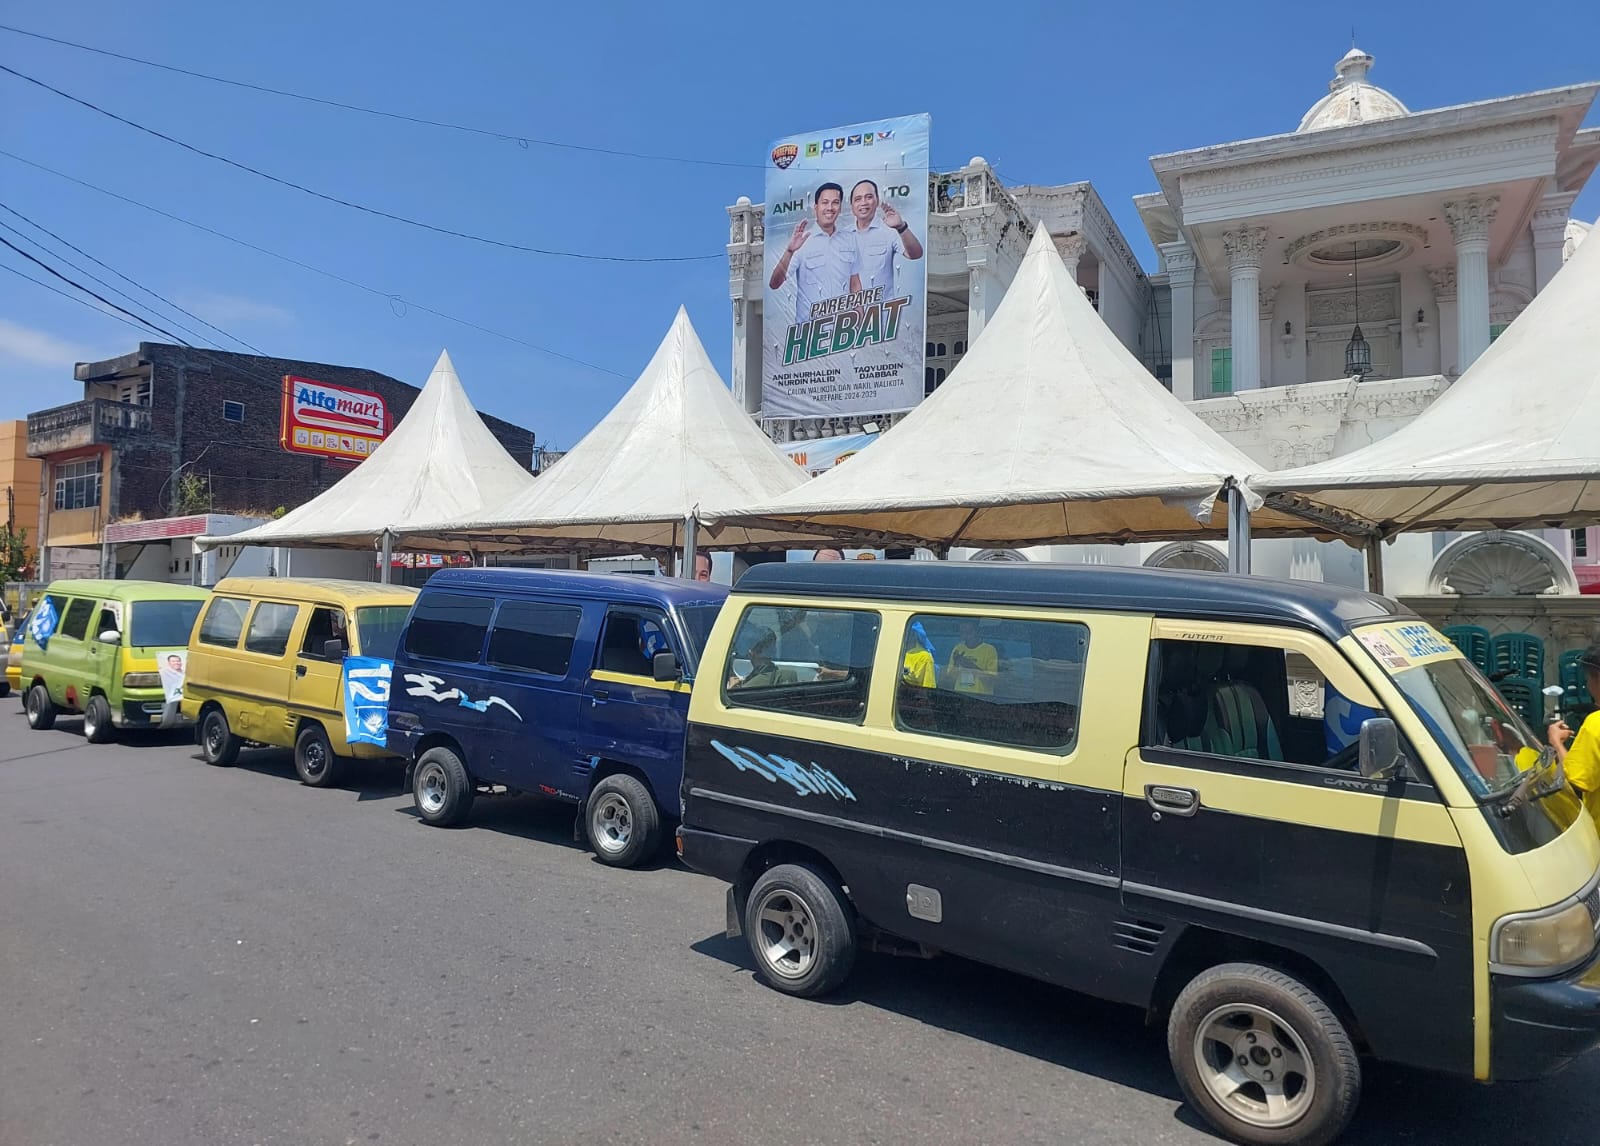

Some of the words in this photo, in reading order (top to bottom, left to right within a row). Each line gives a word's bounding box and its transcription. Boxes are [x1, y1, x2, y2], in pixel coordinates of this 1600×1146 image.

[887, 184, 911, 199] TQ
[772, 198, 804, 215] ANH
[810, 285, 885, 319] PAREPARE
[782, 295, 912, 367] HEBAT
[772, 372, 792, 381] ANDI
[794, 368, 841, 380] NURHALDIN
[854, 362, 904, 374] TAQYUDDIN
[859, 370, 898, 380] DJABBAR
[778, 378, 809, 387] NURDIN
[810, 376, 836, 385] HALID
[788, 386, 807, 396] CALON
[808, 384, 837, 395] WALIKOTA
[838, 384, 851, 392] DAN
[853, 381, 873, 391] WAKIL
[873, 379, 904, 389] WALIKOTA
[298, 388, 379, 417] Alfamart
[812, 392, 843, 402] PAREPARE
[1324, 777, 1369, 790] CARRY
